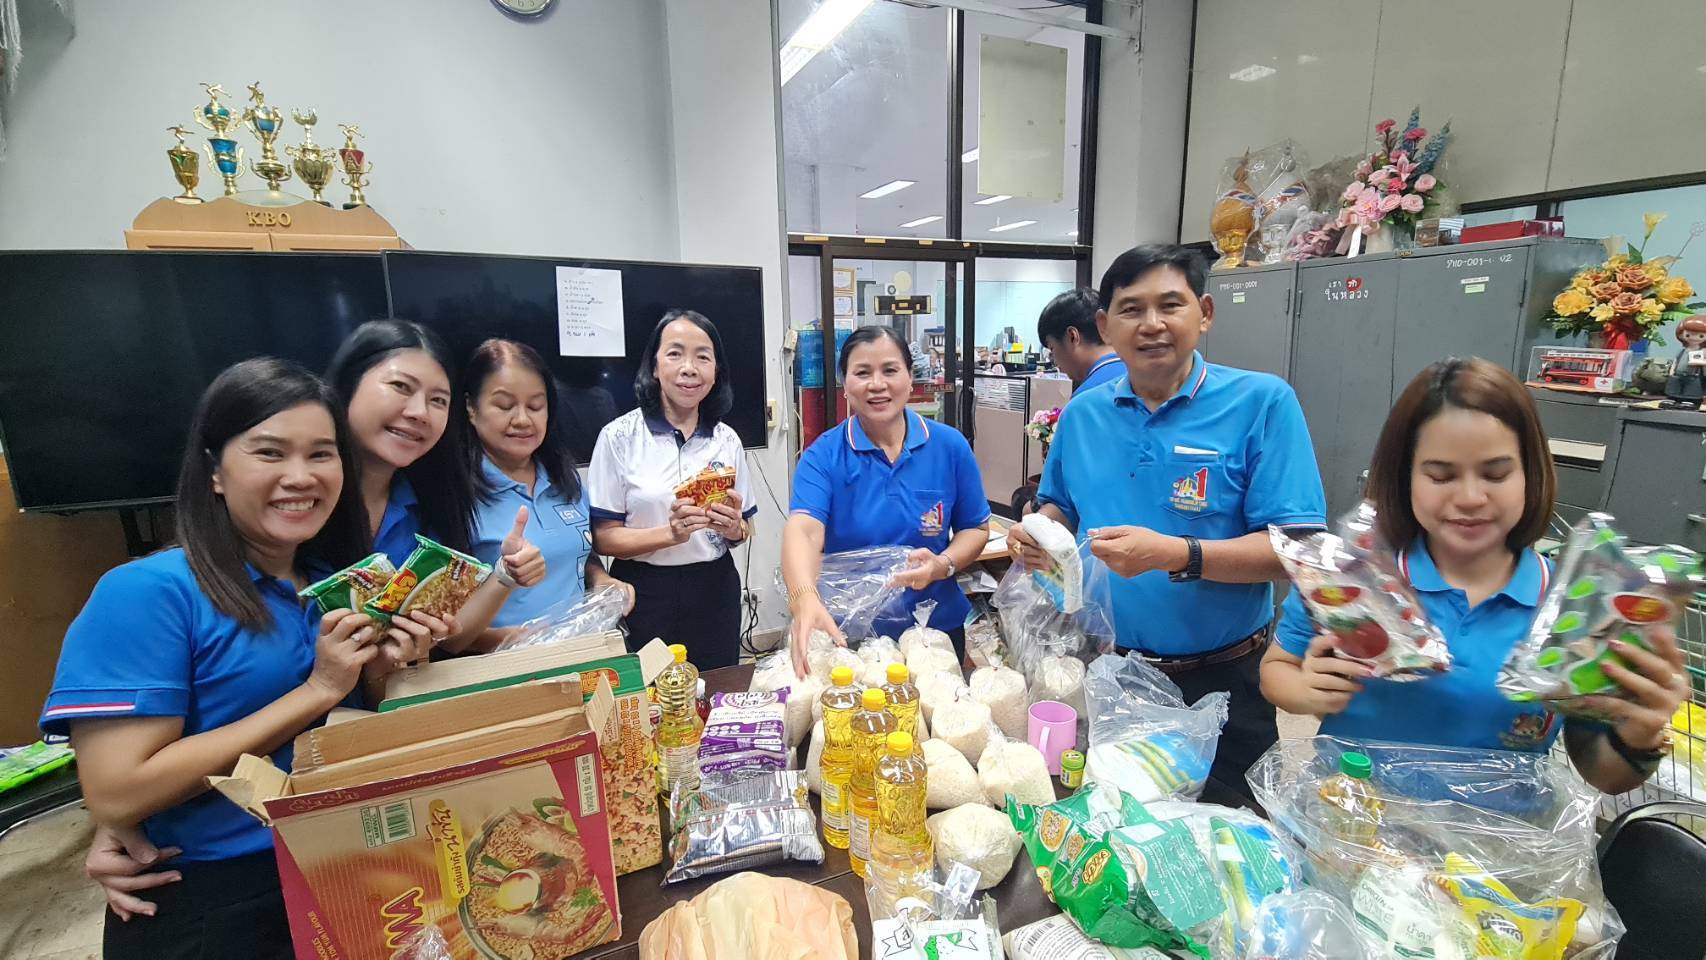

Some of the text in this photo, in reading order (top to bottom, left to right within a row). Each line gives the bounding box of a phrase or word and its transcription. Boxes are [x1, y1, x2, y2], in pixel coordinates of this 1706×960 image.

[246, 211, 291, 228] KBO
[1325, 289, 1369, 301] ในหลวง
